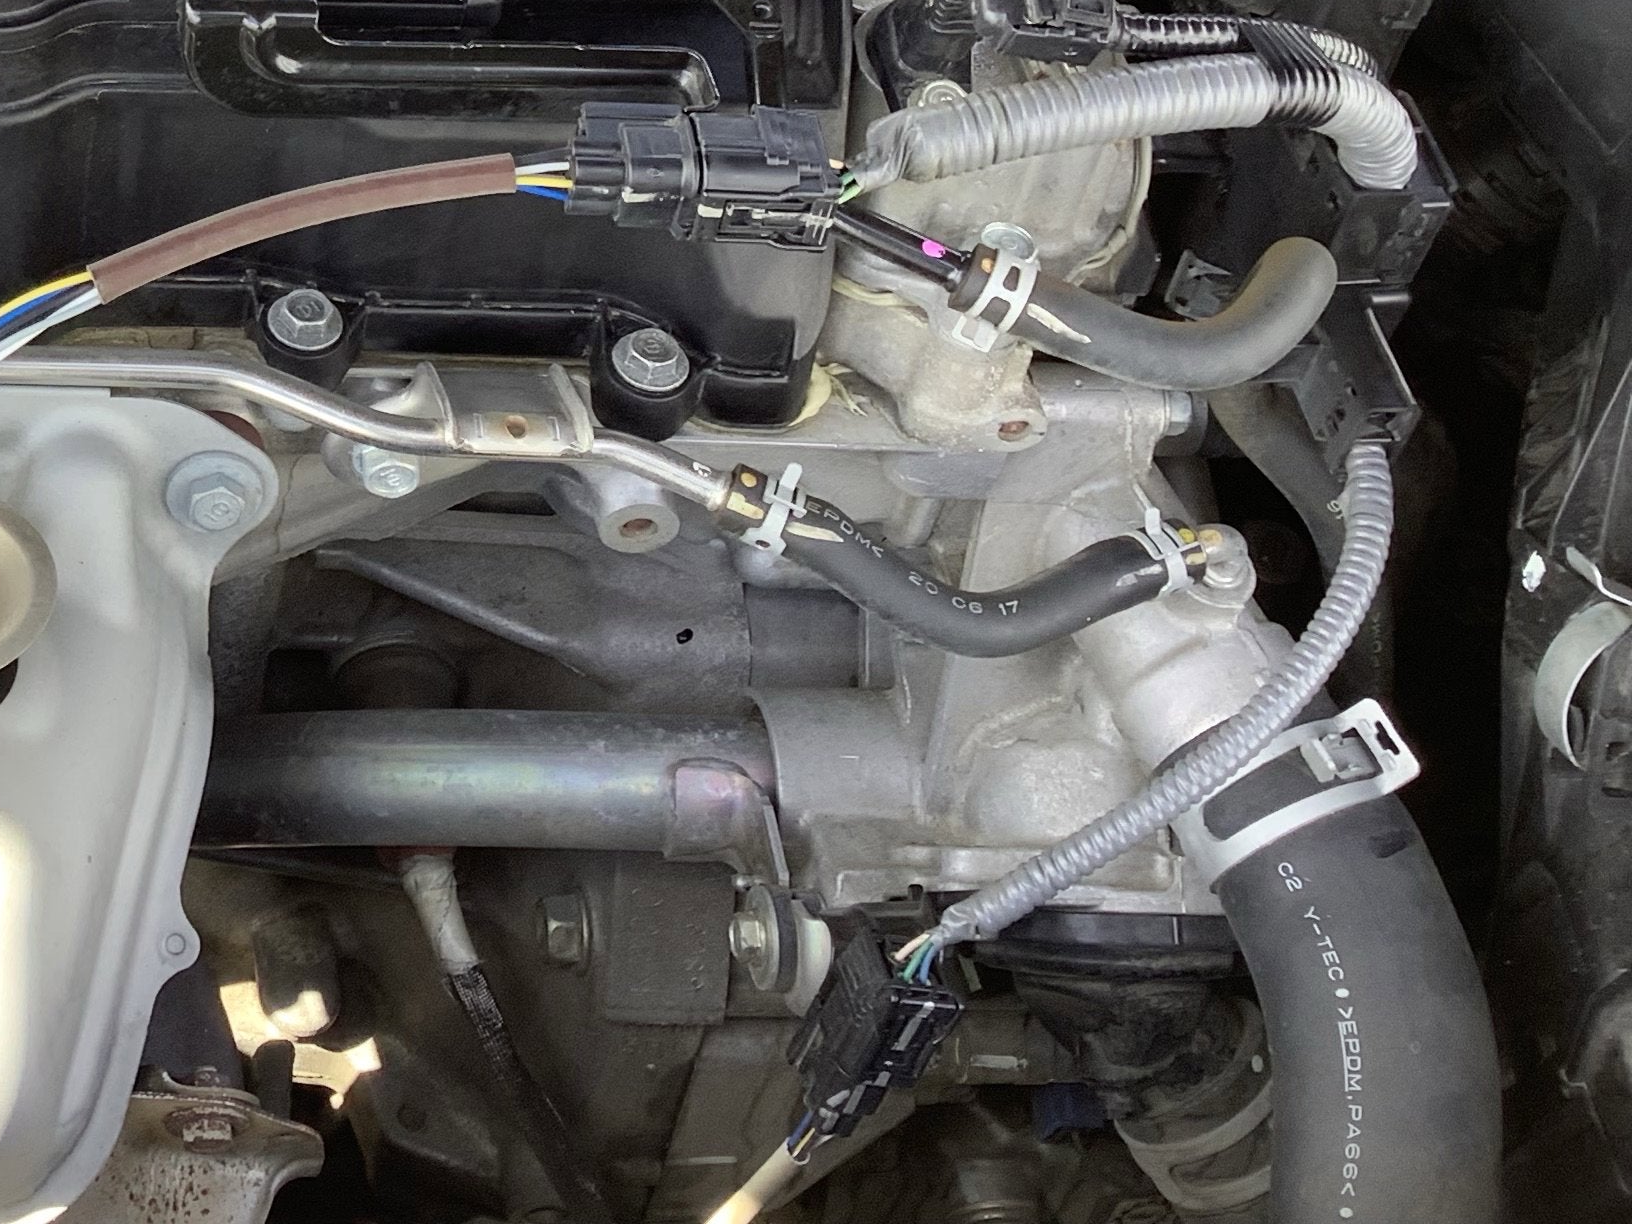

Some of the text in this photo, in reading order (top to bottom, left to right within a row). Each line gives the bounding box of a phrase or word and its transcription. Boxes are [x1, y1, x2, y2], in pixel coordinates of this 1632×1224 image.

[908, 570, 939, 596] 20
[998, 600, 1020, 616] 17
[1277, 861, 1304, 894] C2
[1303, 905, 1345, 982] Y-TEC
